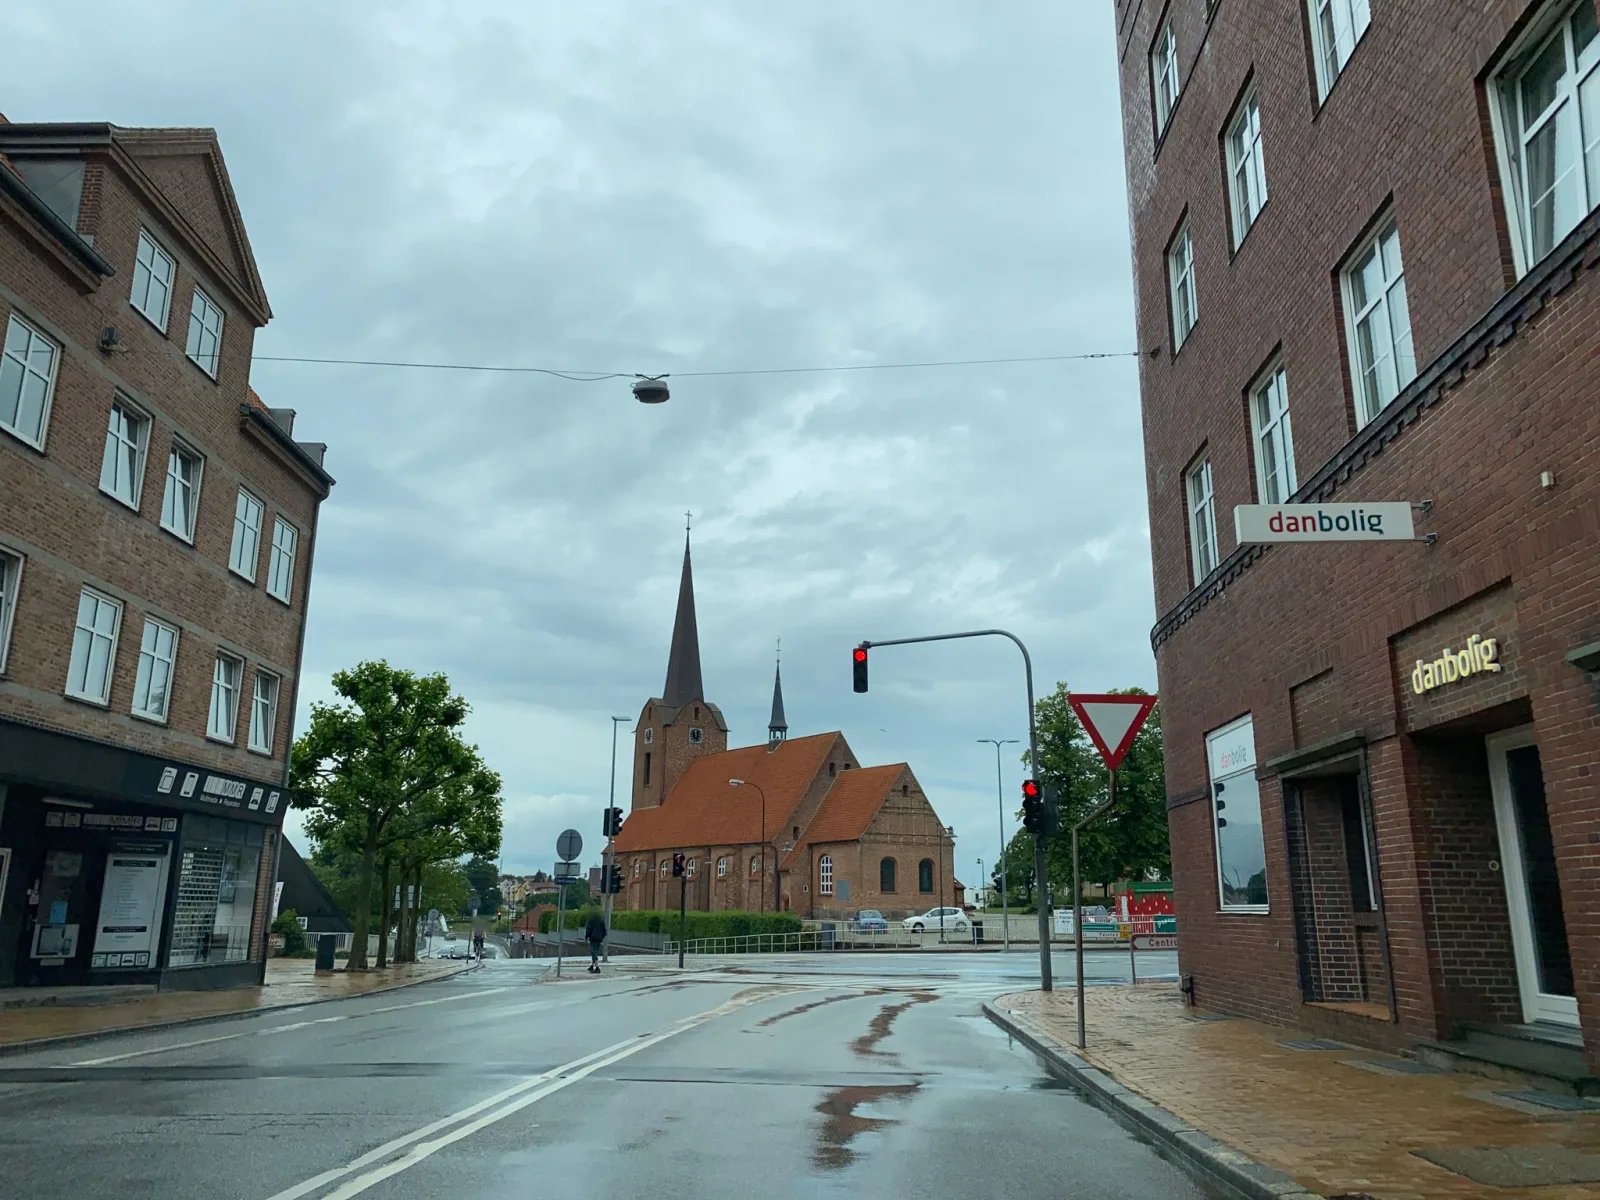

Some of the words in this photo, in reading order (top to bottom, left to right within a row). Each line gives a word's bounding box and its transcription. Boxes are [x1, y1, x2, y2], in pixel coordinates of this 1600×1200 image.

[1269, 509, 1384, 535] danbolig
[1412, 634, 1501, 694] danbolig
[1220, 745, 1247, 769] danbolig
